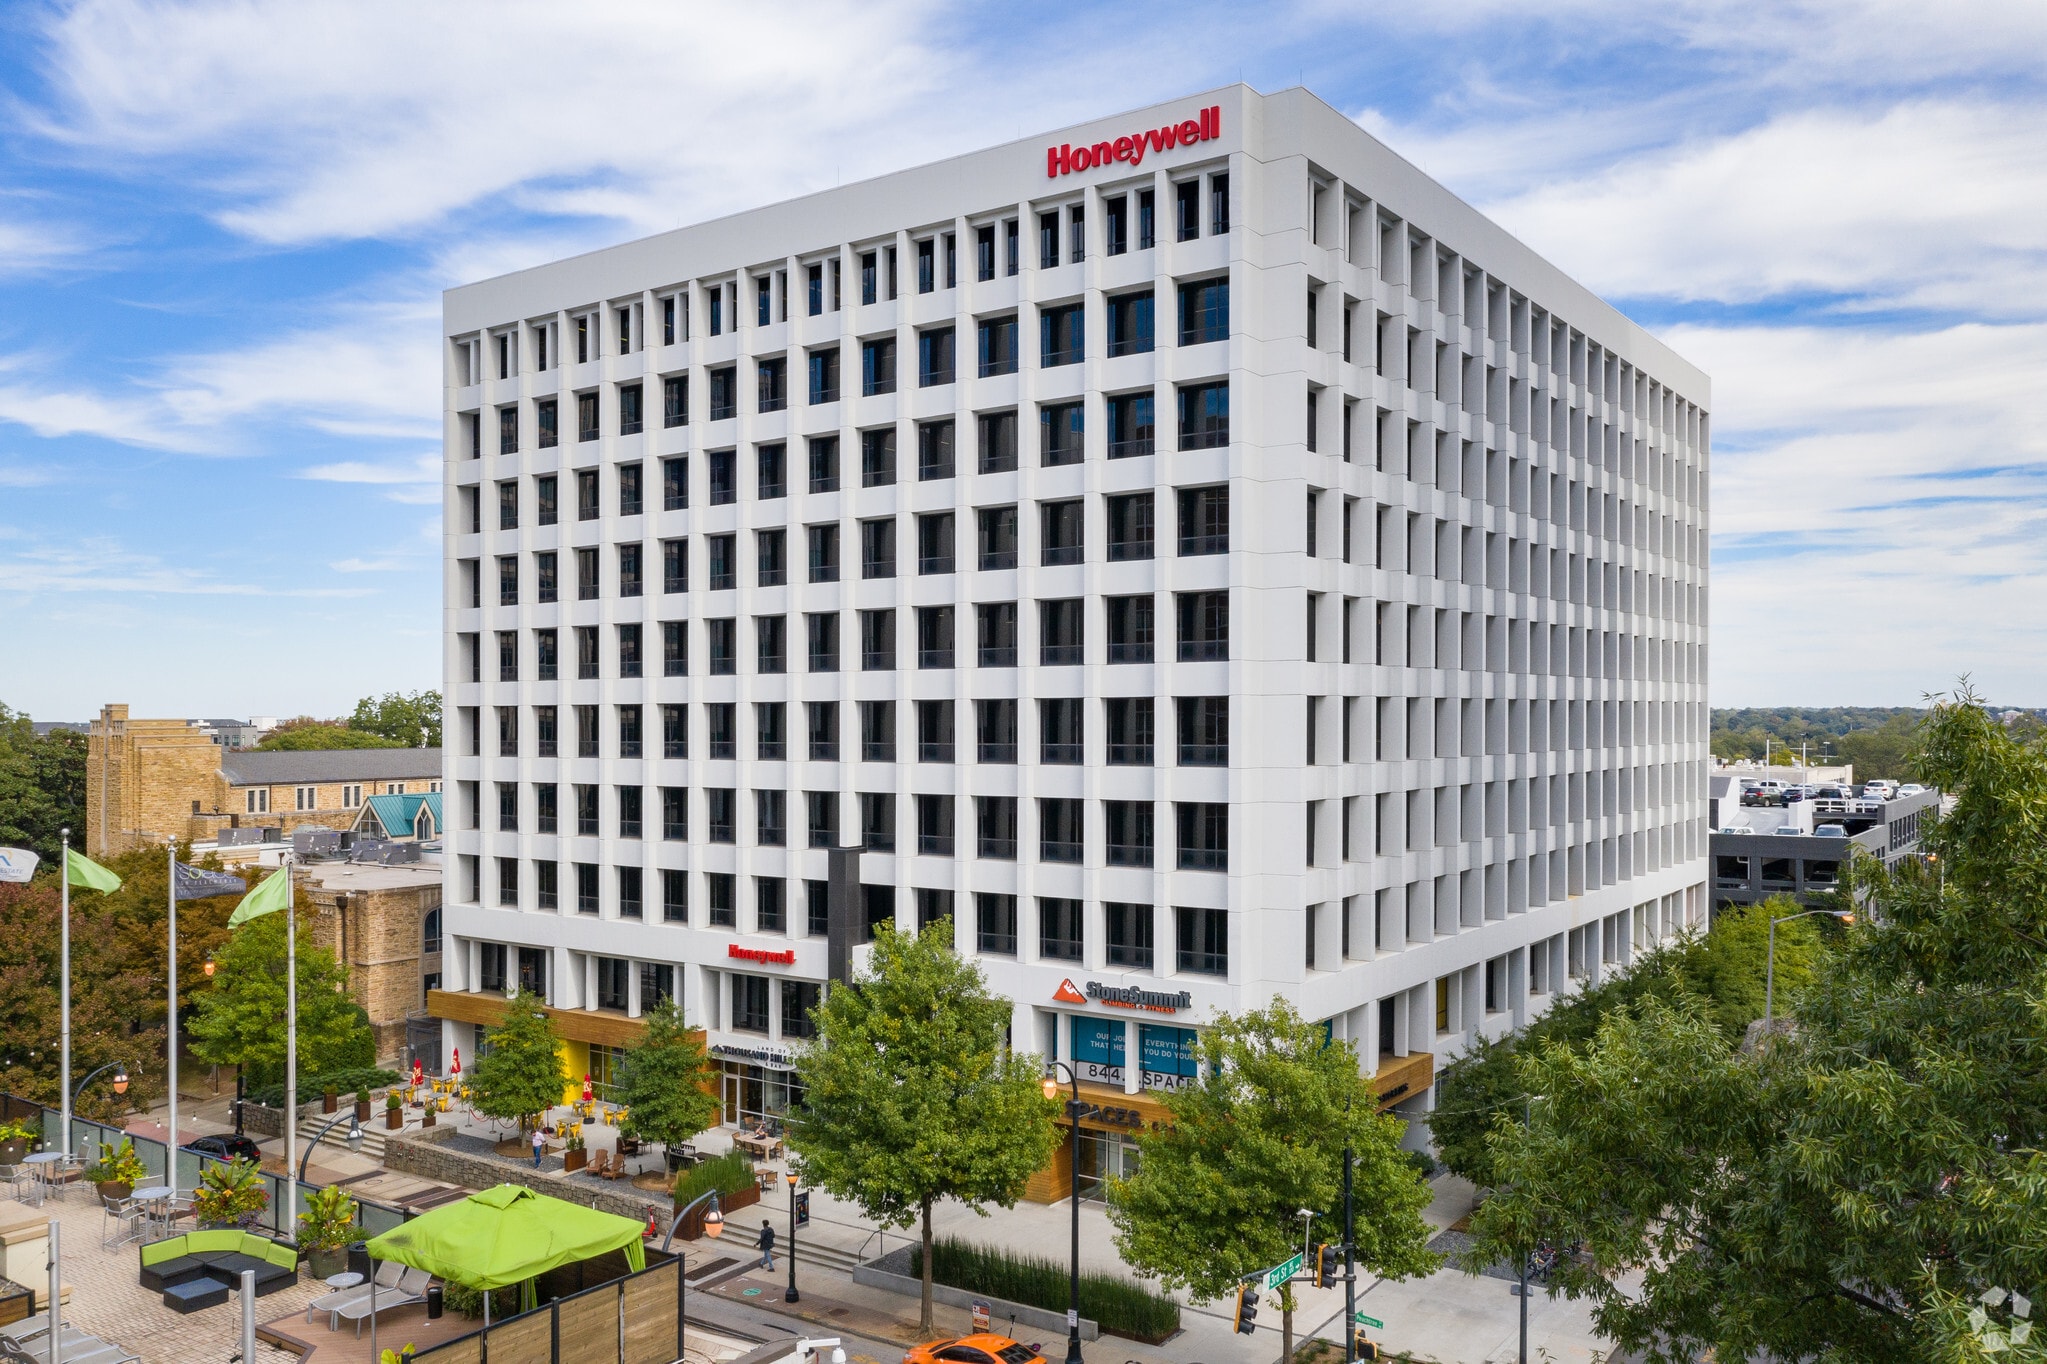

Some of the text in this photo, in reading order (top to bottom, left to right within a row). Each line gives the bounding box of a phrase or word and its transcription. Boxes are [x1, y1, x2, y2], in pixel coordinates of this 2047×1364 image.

[1048, 105, 1220, 178] Honeywell
[728, 944, 795, 964] Honeywell
[1086, 981, 1191, 1008] StoneSummit
[1101, 999, 1136, 1010] CLIMBING
[1144, 1004, 1176, 1014] FITNESS
[722, 1045, 770, 1061] THOUSAND
[1090, 1040, 1109, 1049] THAT
[1144, 1048, 1159, 1057] YOU
[1162, 1050, 1172, 1058] DO
[1270, 1265, 1287, 1287] 3rd St
